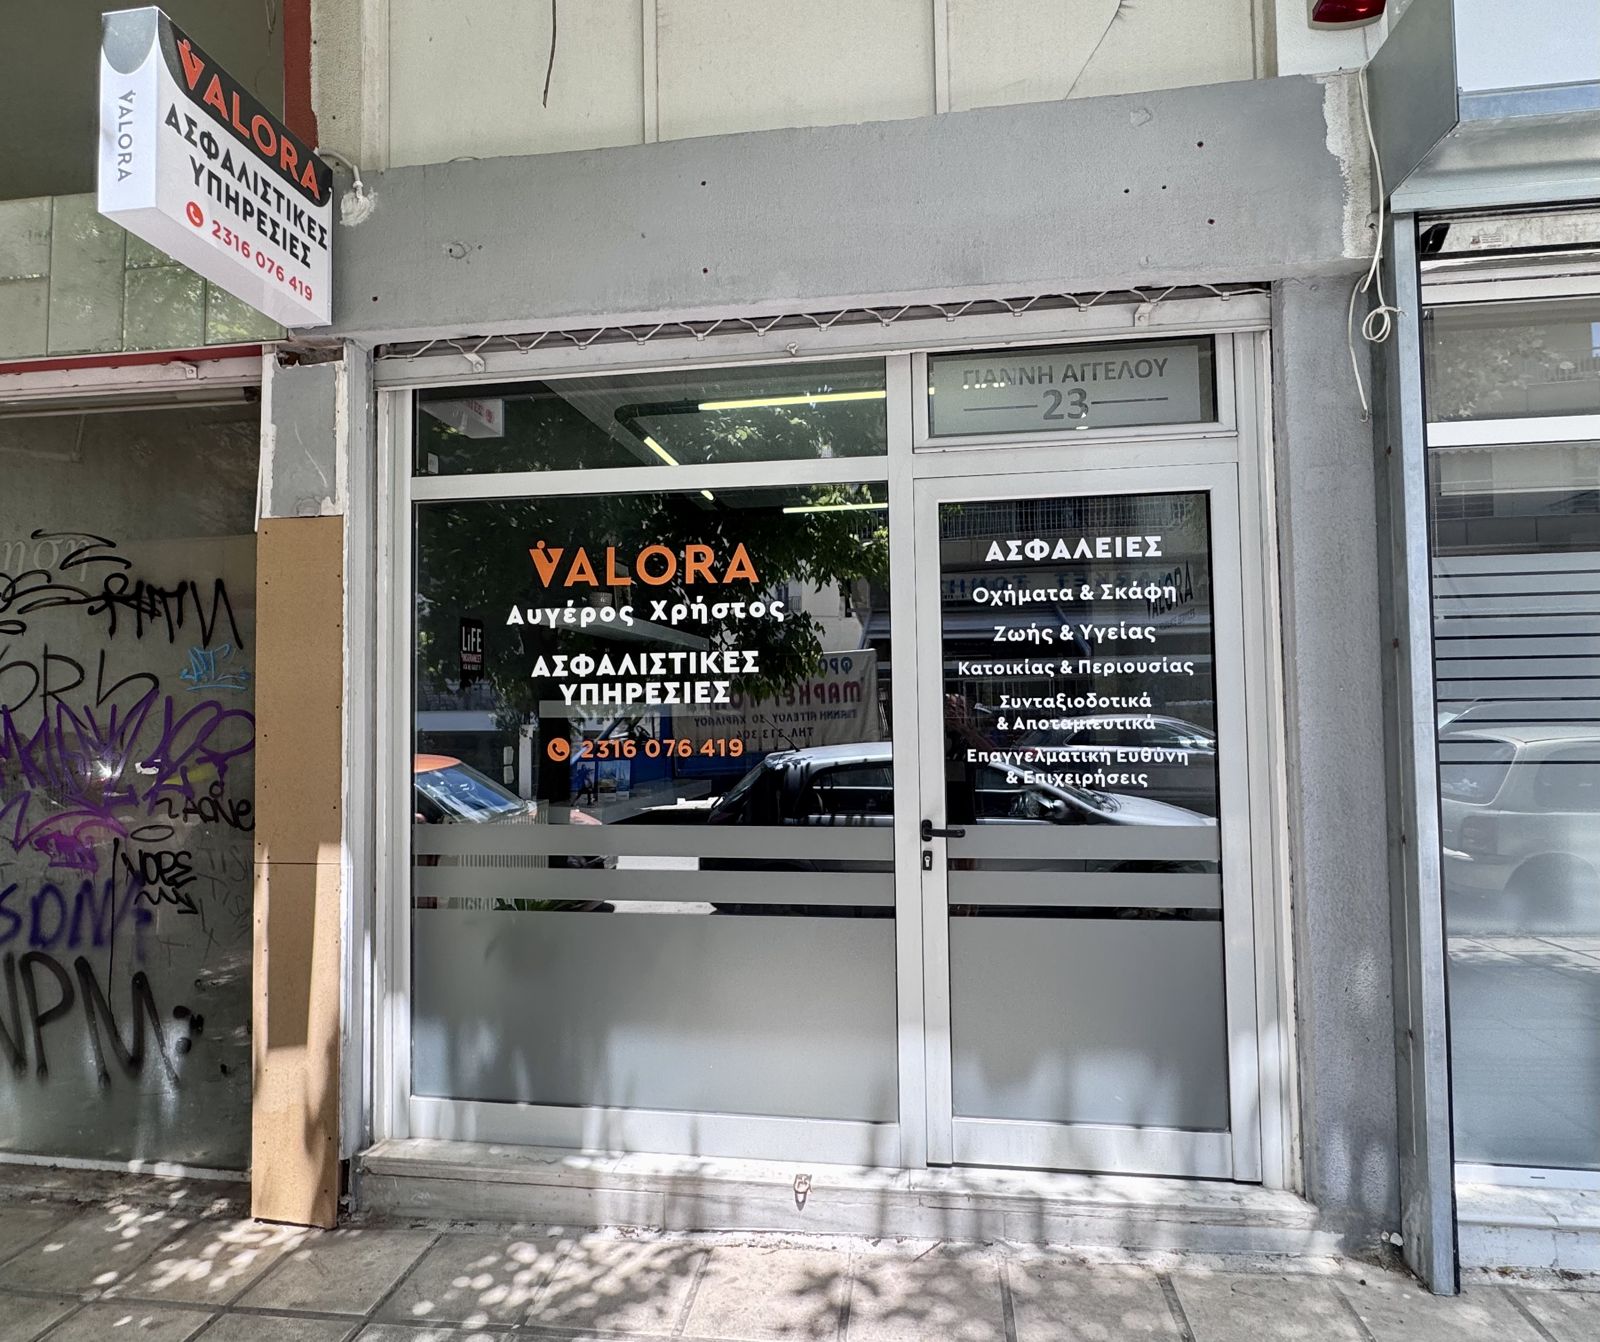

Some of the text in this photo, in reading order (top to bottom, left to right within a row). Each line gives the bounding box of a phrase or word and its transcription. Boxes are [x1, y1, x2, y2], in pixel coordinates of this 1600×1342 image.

[177, 39, 321, 201] VALORA
[117, 89, 136, 182] VALORA
[164, 103, 328, 251] ΑΣΦΑΛΙΣΤΙΚΕΣ
[189, 155, 311, 269] ΥΠΗΡΕΣΙΕΣ
[212, 220, 313, 302] 2316 076 419
[963, 357, 1168, 386] ΓΙΑΝΝΗ ΑΓΓΕΛΟΥ
[1042, 388, 1090, 421] 23
[985, 535, 1162, 562] ΑΣΦΑΛΕΙΕΣ
[529, 540, 760, 588] VALORA
[972, 581, 1177, 606] Οχήματα & Σκάφη
[506, 596, 785, 628] Αυγέρος Χρήστος
[994, 621, 1156, 644] Ζωής & Υγείας
[531, 650, 760, 678] ΑΣΦΑΛΙΣΤΙΚΕΣ
[958, 656, 1194, 678] Κατοικίας & Περιουσίας
[559, 680, 731, 706] ΥΠΗΡΕΣΙΕΣ
[999, 692, 1152, 710] Συνταξιοδοτικά
[997, 716, 1156, 733] & Αποταμιευτικά
[581, 737, 744, 759] 2316 076 419
[966, 747, 1189, 765] Επαγγελματική Ευθύνη
[1006, 768, 1148, 788] & Επιχειρήσεις
